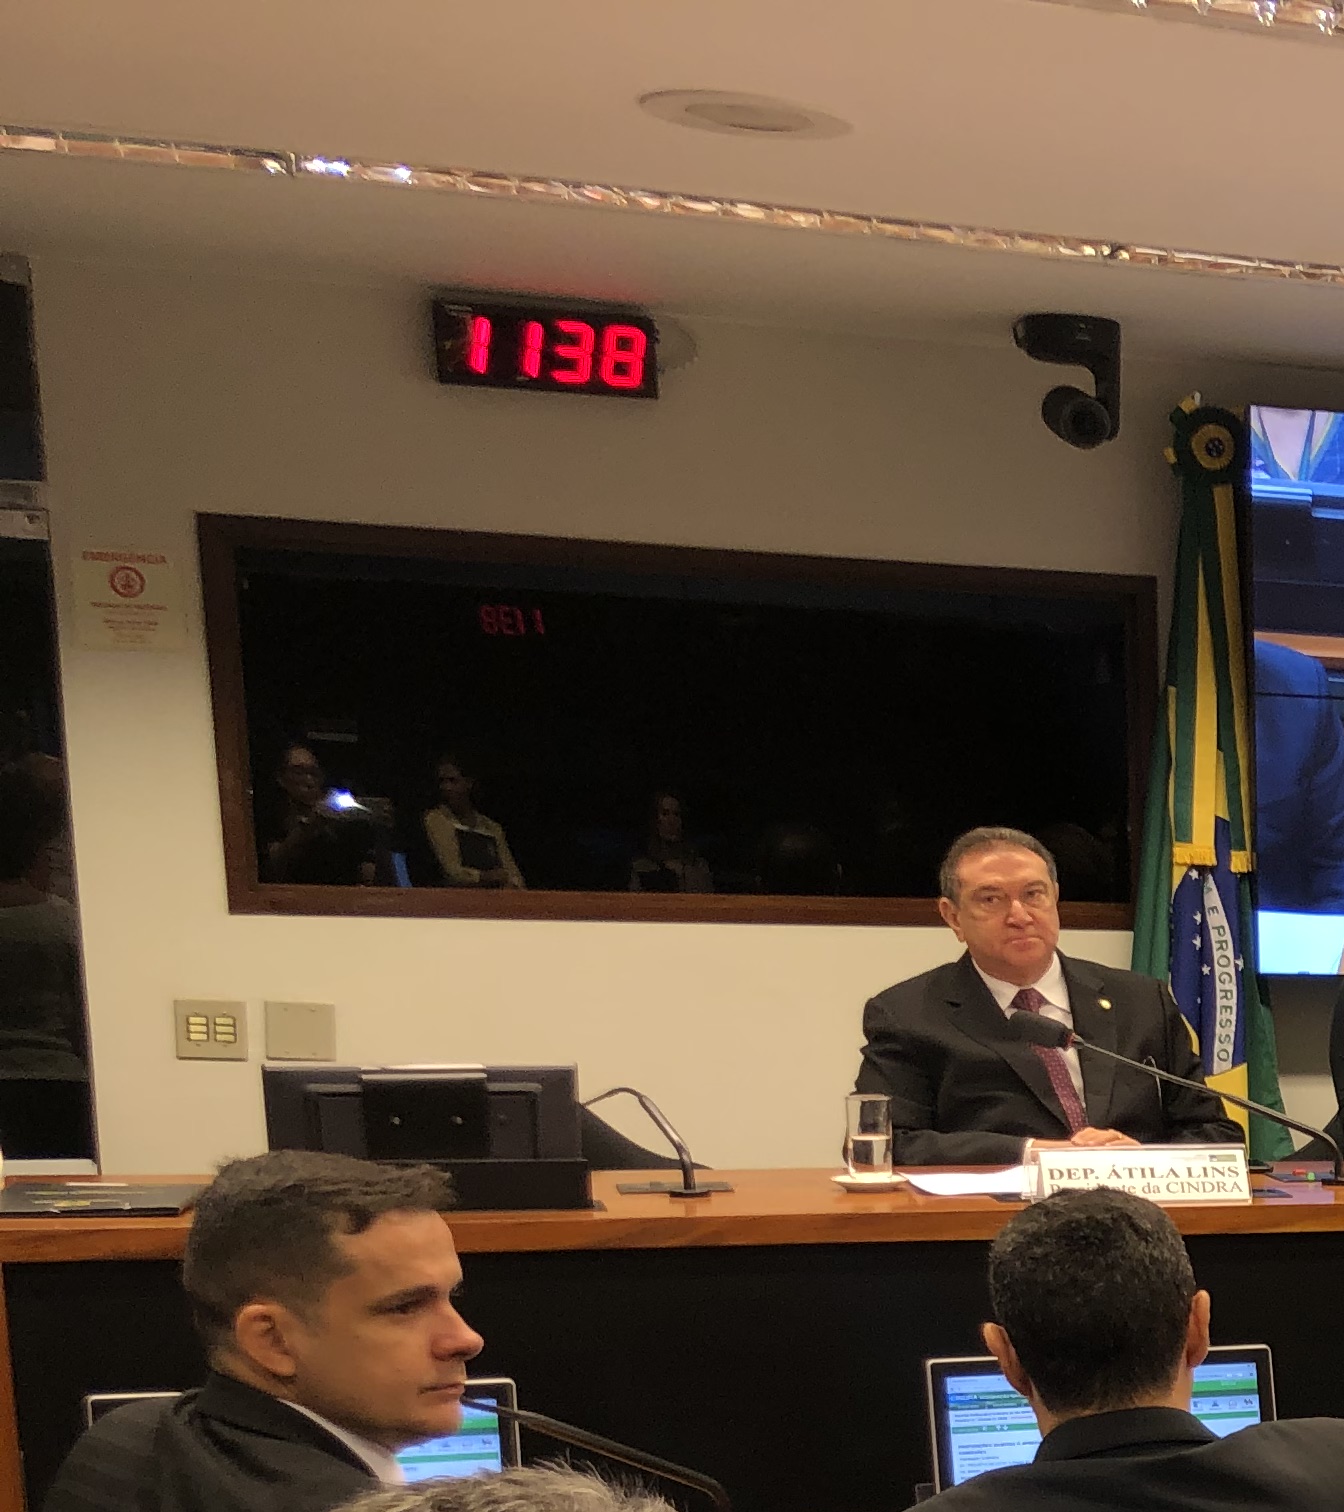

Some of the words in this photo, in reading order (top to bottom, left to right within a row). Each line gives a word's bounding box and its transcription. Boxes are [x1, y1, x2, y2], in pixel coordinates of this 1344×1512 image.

[465, 315, 648, 390] 1138
[1207, 906, 1219, 917] E
[1211, 925, 1234, 1062] PROGRESSO
[1048, 1168, 1100, 1181] DEP.
[1107, 1164, 1184, 1180] ÁTILA
[1187, 1166, 1240, 1179] LINS
[1142, 1182, 1160, 1194] da
[1166, 1181, 1243, 1193] CINDRA
